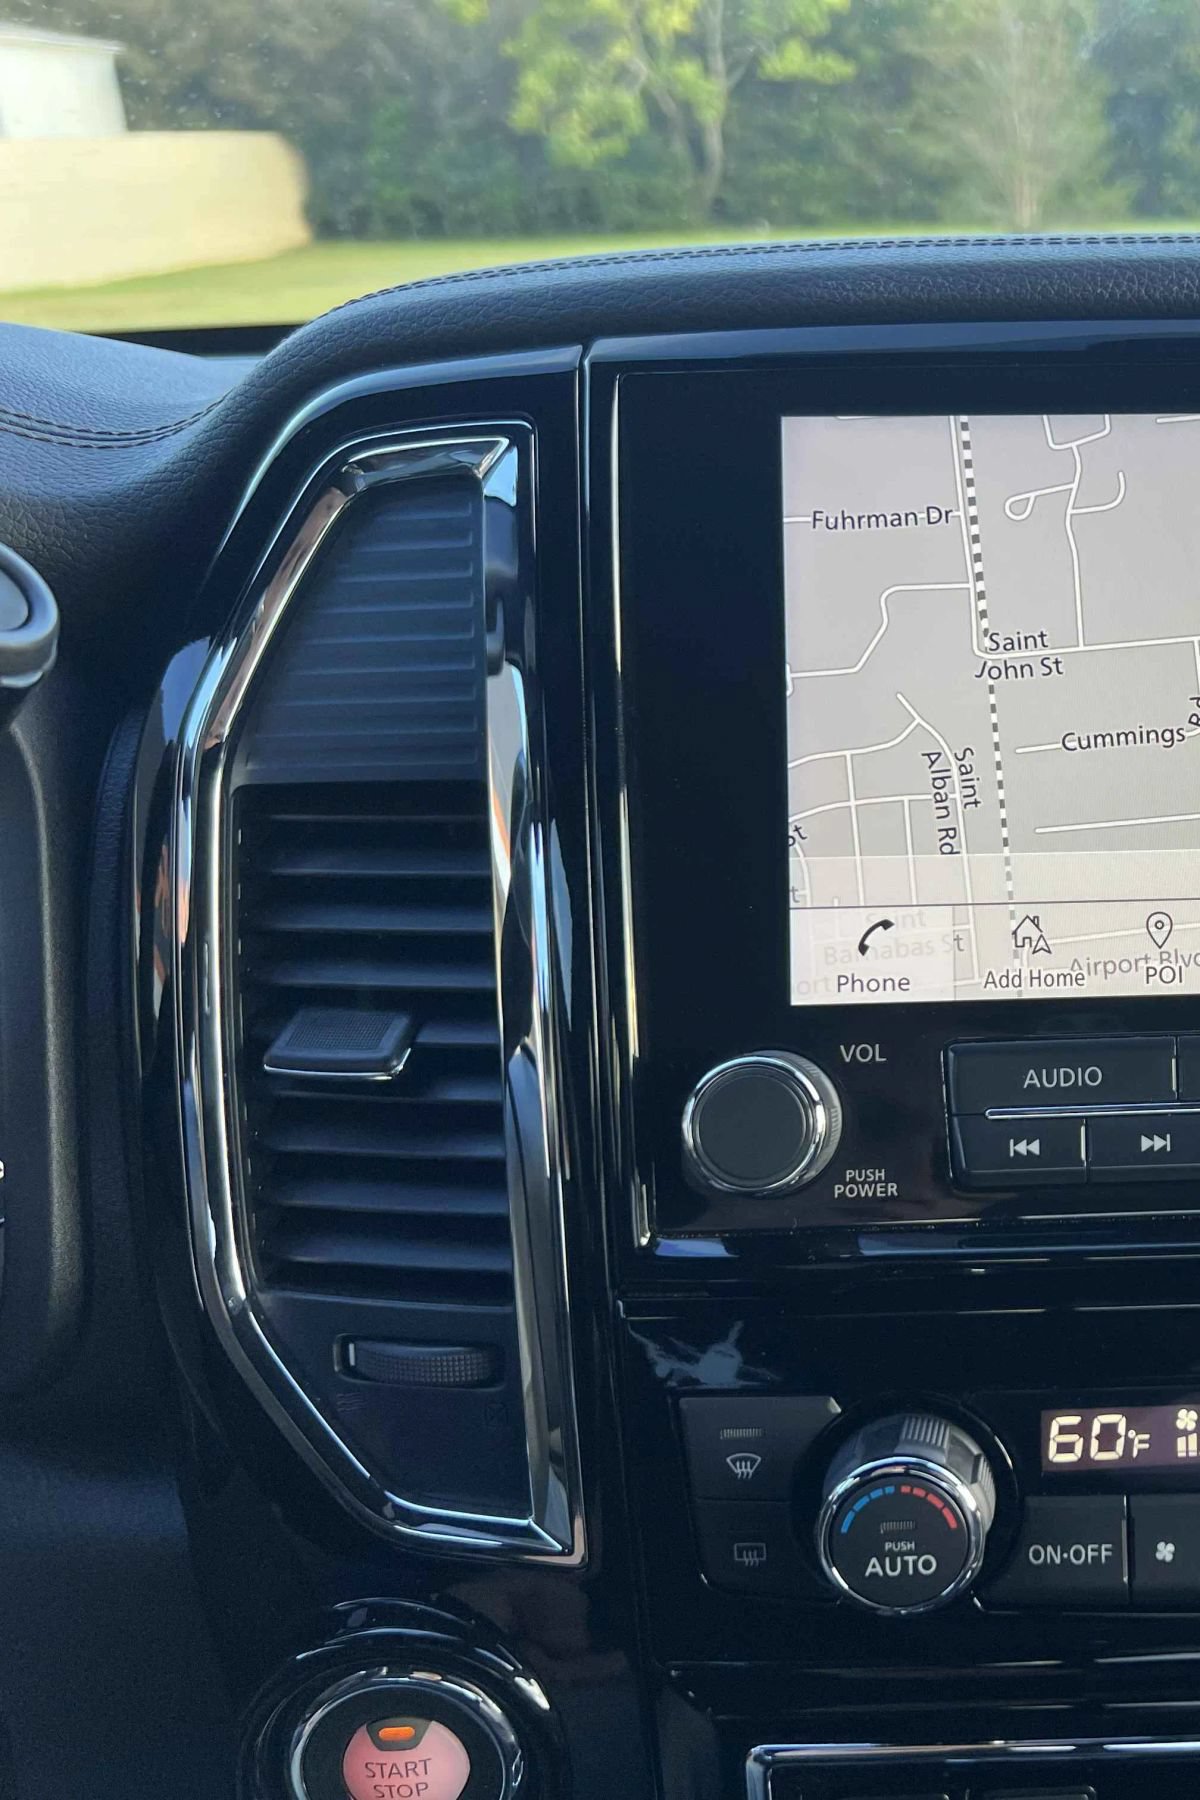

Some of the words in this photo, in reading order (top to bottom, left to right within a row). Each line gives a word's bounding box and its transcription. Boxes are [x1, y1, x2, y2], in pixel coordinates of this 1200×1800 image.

[811, 507, 918, 531] Fuhrman
[926, 506, 953, 526] Dr
[988, 630, 1049, 651] Saint
[975, 659, 1034, 680] John
[1040, 657, 1064, 676] St
[1061, 726, 1186, 751] Cummings
[955, 747, 981, 809] Saint
[922, 752, 952, 819] Alban
[938, 827, 961, 855] Rd
[1070, 954, 1151, 980] Airport
[1145, 965, 1183, 985] POI
[837, 973, 911, 993] Phone
[984, 968, 1023, 989] Add
[1030, 969, 1086, 988] Home
[840, 1043, 887, 1062] VOL
[1023, 1066, 1103, 1089] AUDIO
[845, 1168, 886, 1182] PUSH
[834, 1182, 899, 1198] POWER
[885, 1541, 916, 1552] PUSH
[864, 1554, 938, 1578] AUTO
[364, 1758, 432, 1779] START
[373, 1781, 429, 1799] STOP
